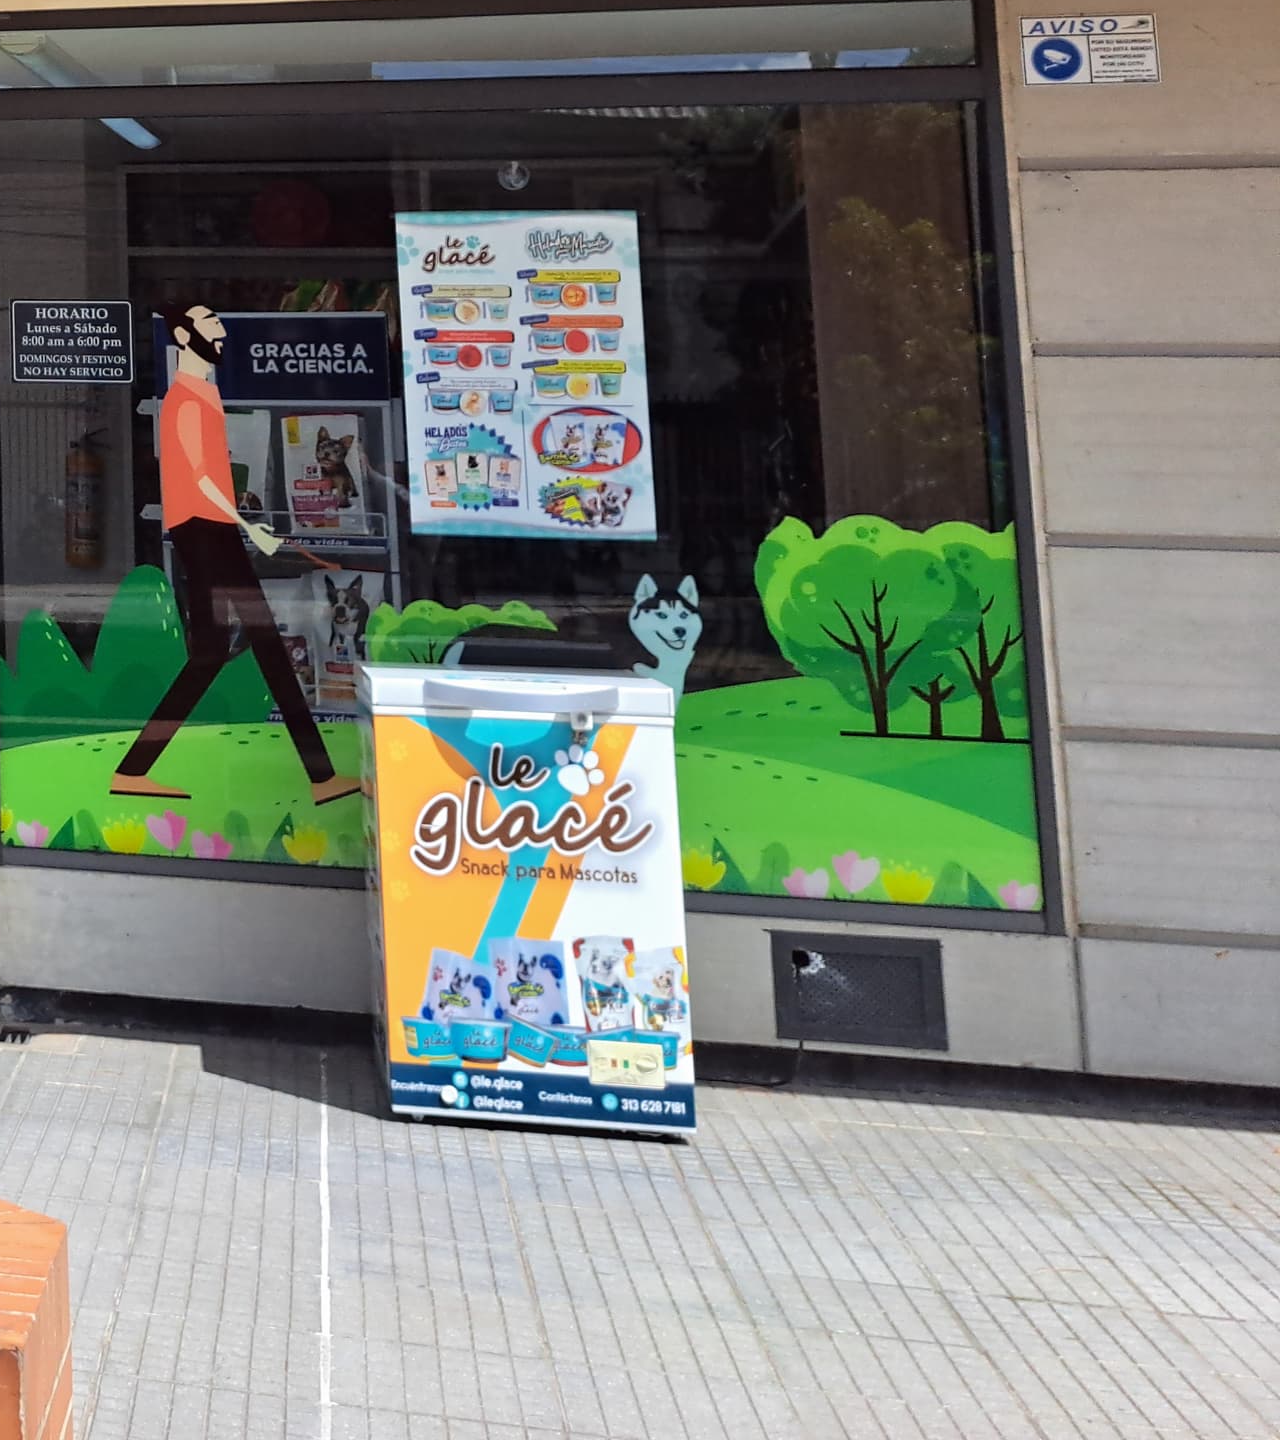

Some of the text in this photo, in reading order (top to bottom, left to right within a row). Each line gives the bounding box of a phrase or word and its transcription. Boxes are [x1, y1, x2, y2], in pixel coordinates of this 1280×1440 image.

[1028, 19, 1118, 34] AVISO
[446, 235, 465, 249] le
[422, 245, 496, 272] glacé
[35, 307, 109, 319] HORARIO
[26, 322, 117, 334] Lunes a Sábado
[22, 335, 122, 350] 8:00 am a 6:00 pm
[249, 343, 368, 358] GRACIAS A
[19, 354, 127, 365] DOMINGOS Y FESTIVOS
[252, 359, 375, 374] LA CIENCIA.
[23, 366, 123, 377] NO HAY SERVICIO
[425, 426, 468, 438] HELADOS
[491, 743, 550, 789] le
[411, 780, 654, 874] glacé
[461, 859, 639, 884] Snack para Mascotas
[621, 1098, 639, 1111] 313
[641, 1099, 662, 1112] 628
